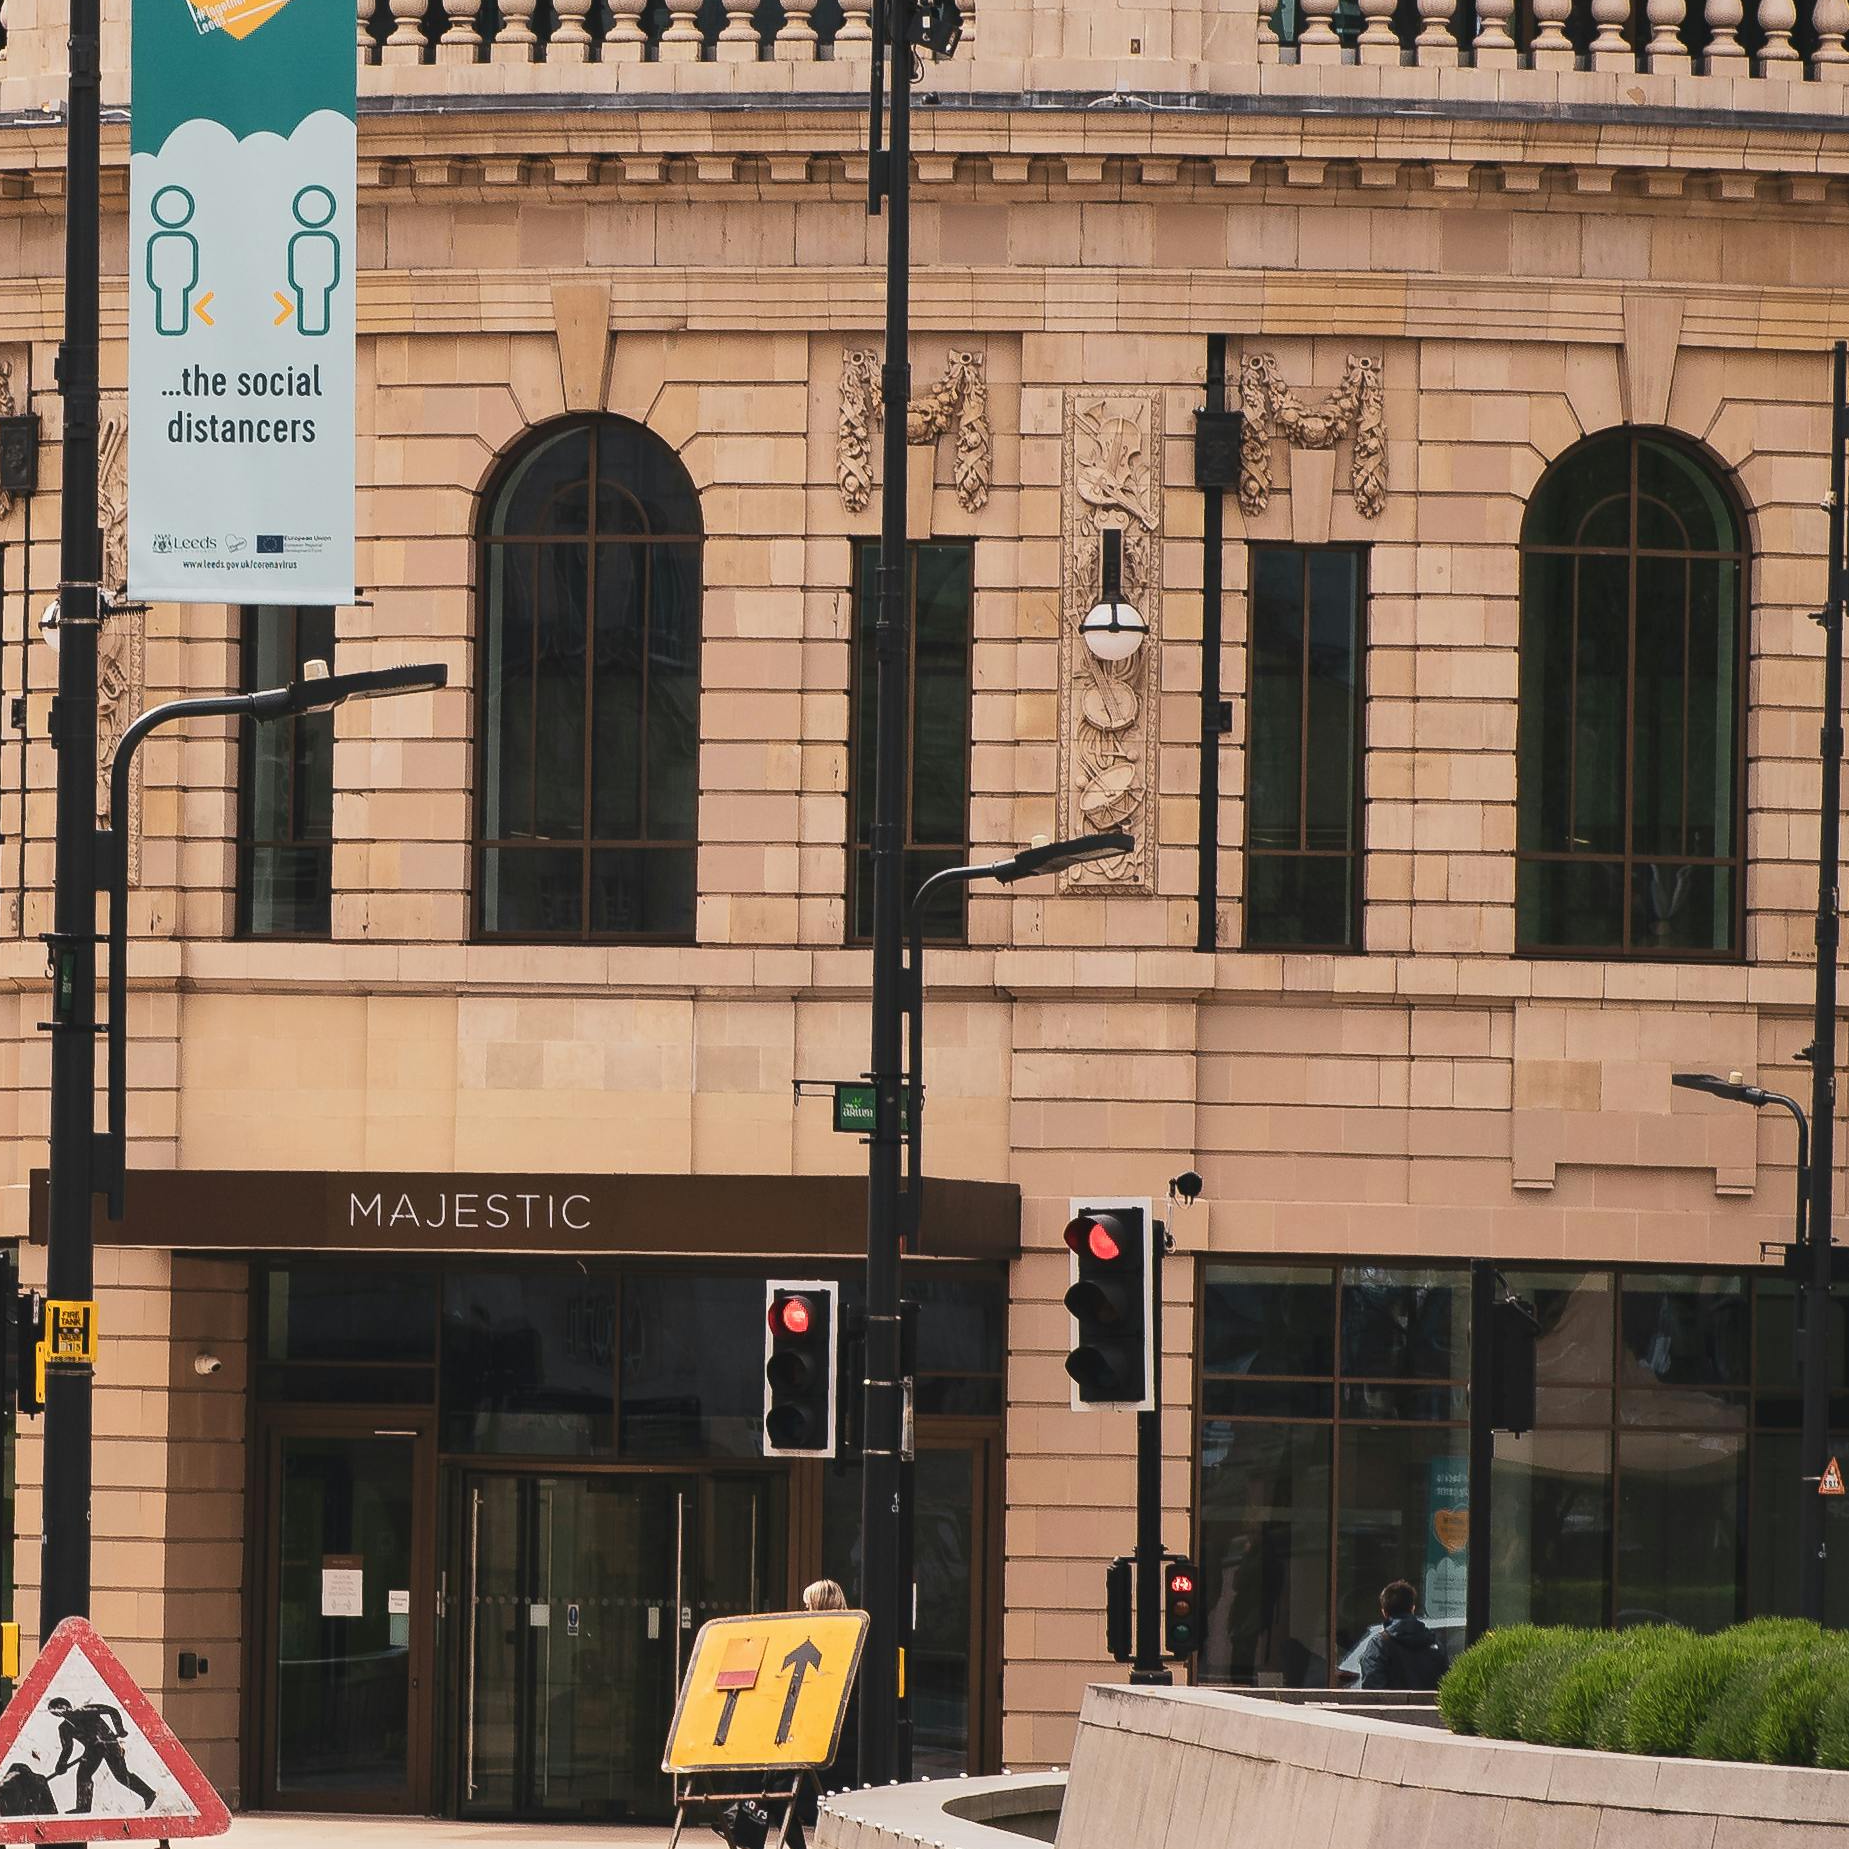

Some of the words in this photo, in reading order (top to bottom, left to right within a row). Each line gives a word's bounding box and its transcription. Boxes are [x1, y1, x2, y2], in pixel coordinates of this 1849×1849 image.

[161, 365, 227, 398] ...the
[237, 365, 323, 398] social
[167, 412, 317, 445] distancers
[173, 535, 217, 550] Leeds
[350, 1193, 592, 1230] MAJESTIC
